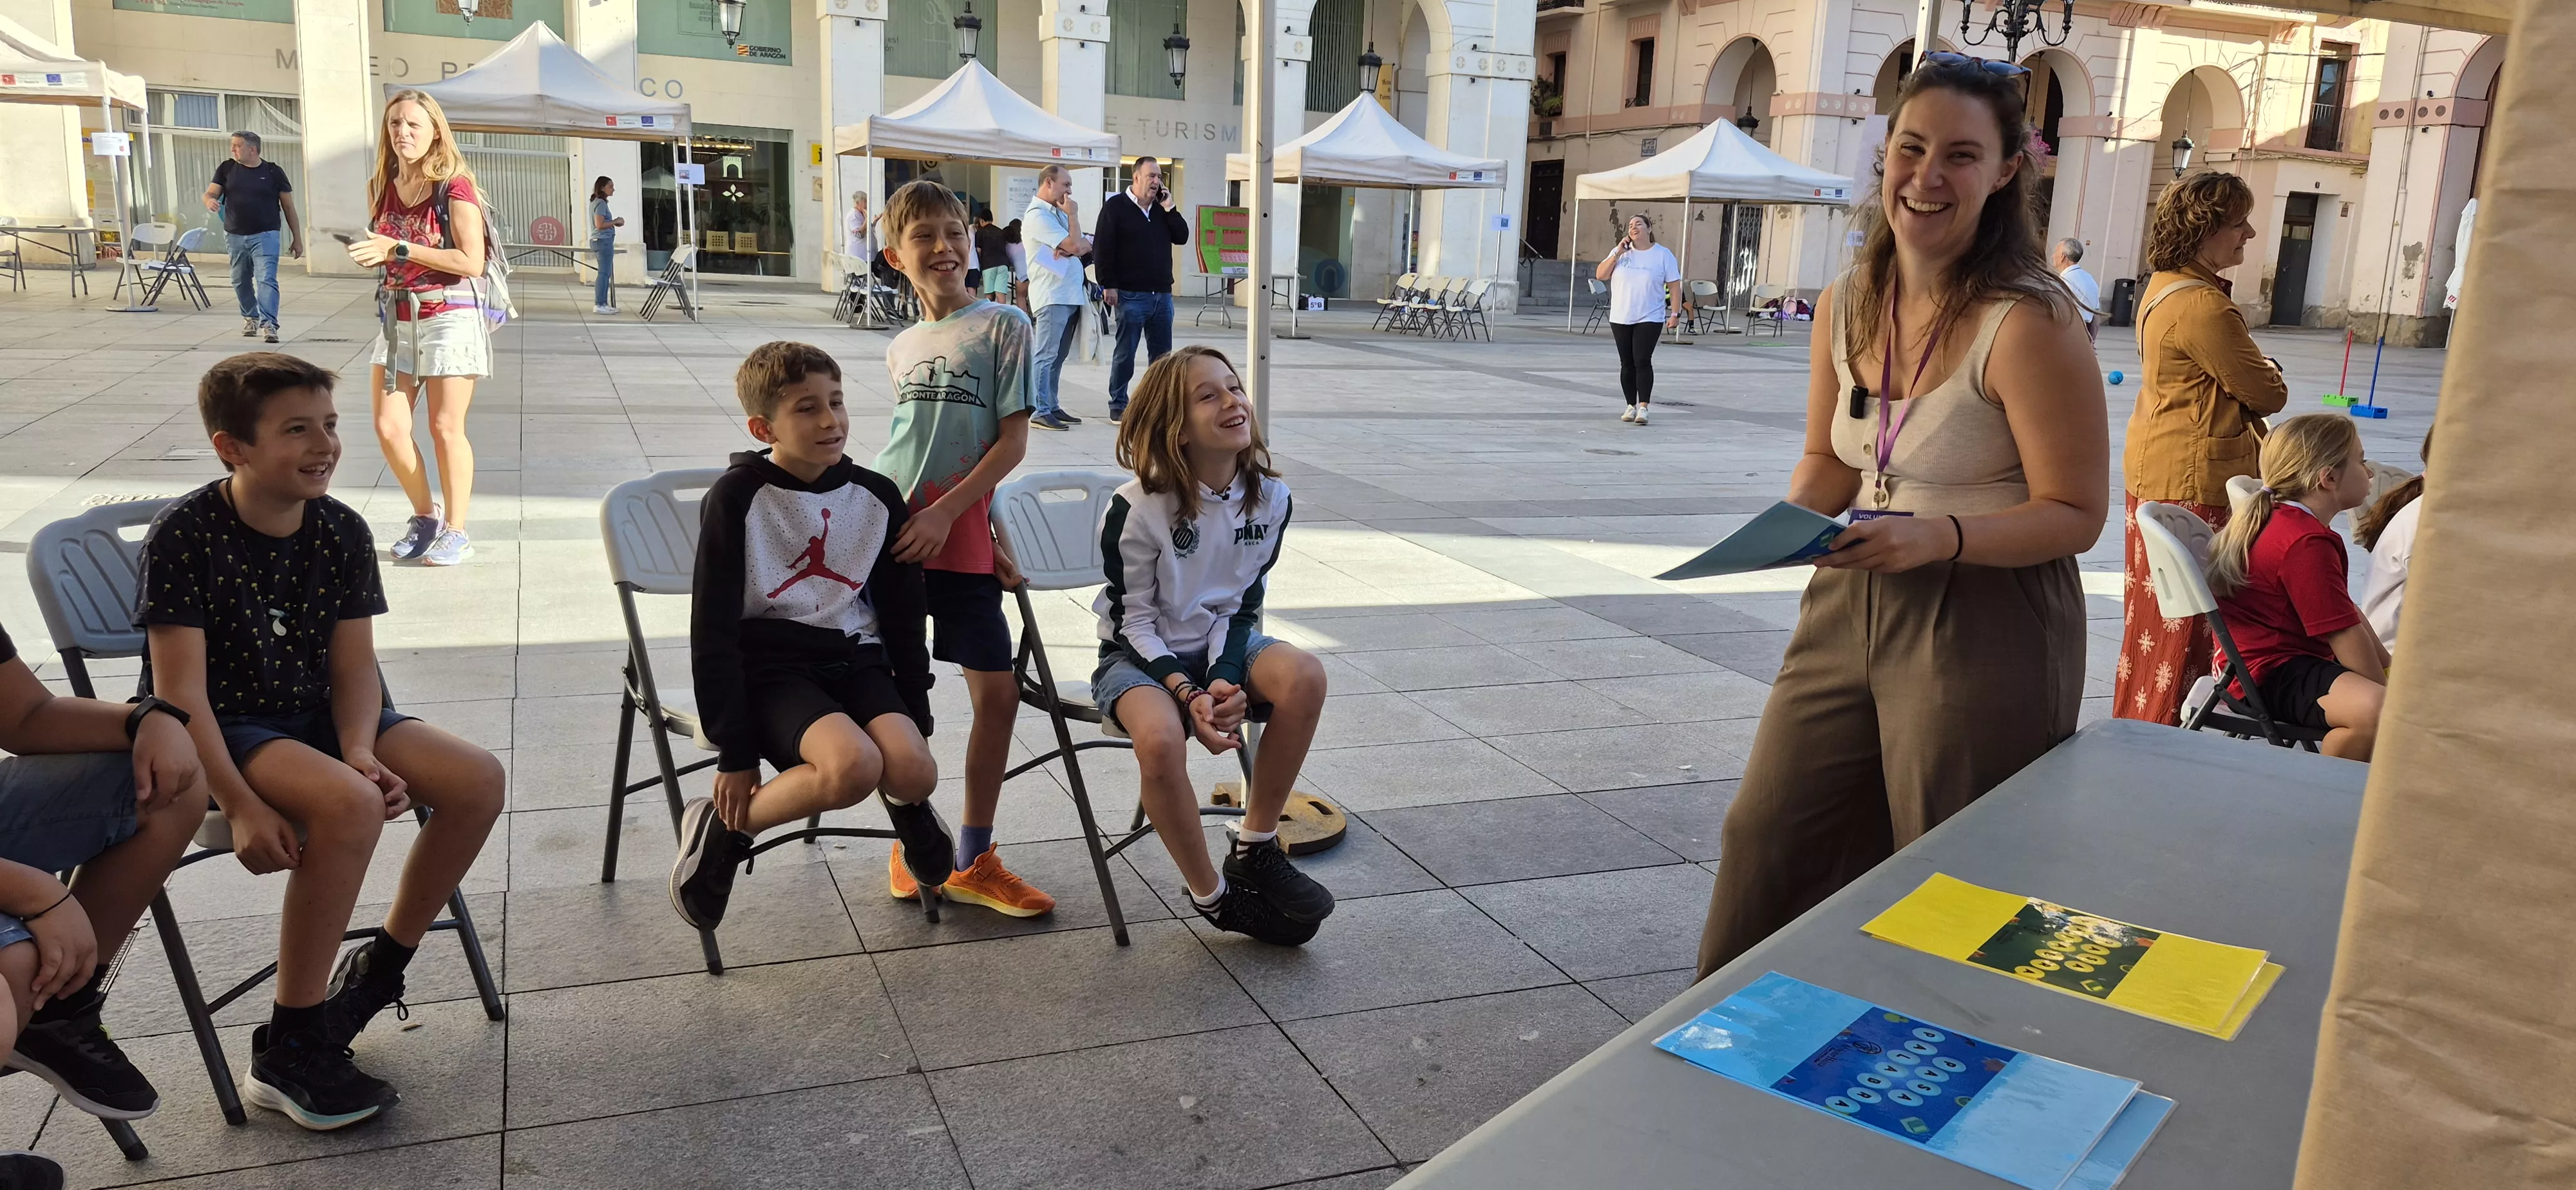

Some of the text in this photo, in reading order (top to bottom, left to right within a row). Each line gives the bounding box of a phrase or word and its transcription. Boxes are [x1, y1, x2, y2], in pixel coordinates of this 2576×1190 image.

[1138, 118, 1236, 142] TURISM
[1834, 1030, 1937, 1108] PALABRA
[1896, 1060, 1957, 1102] PASA
